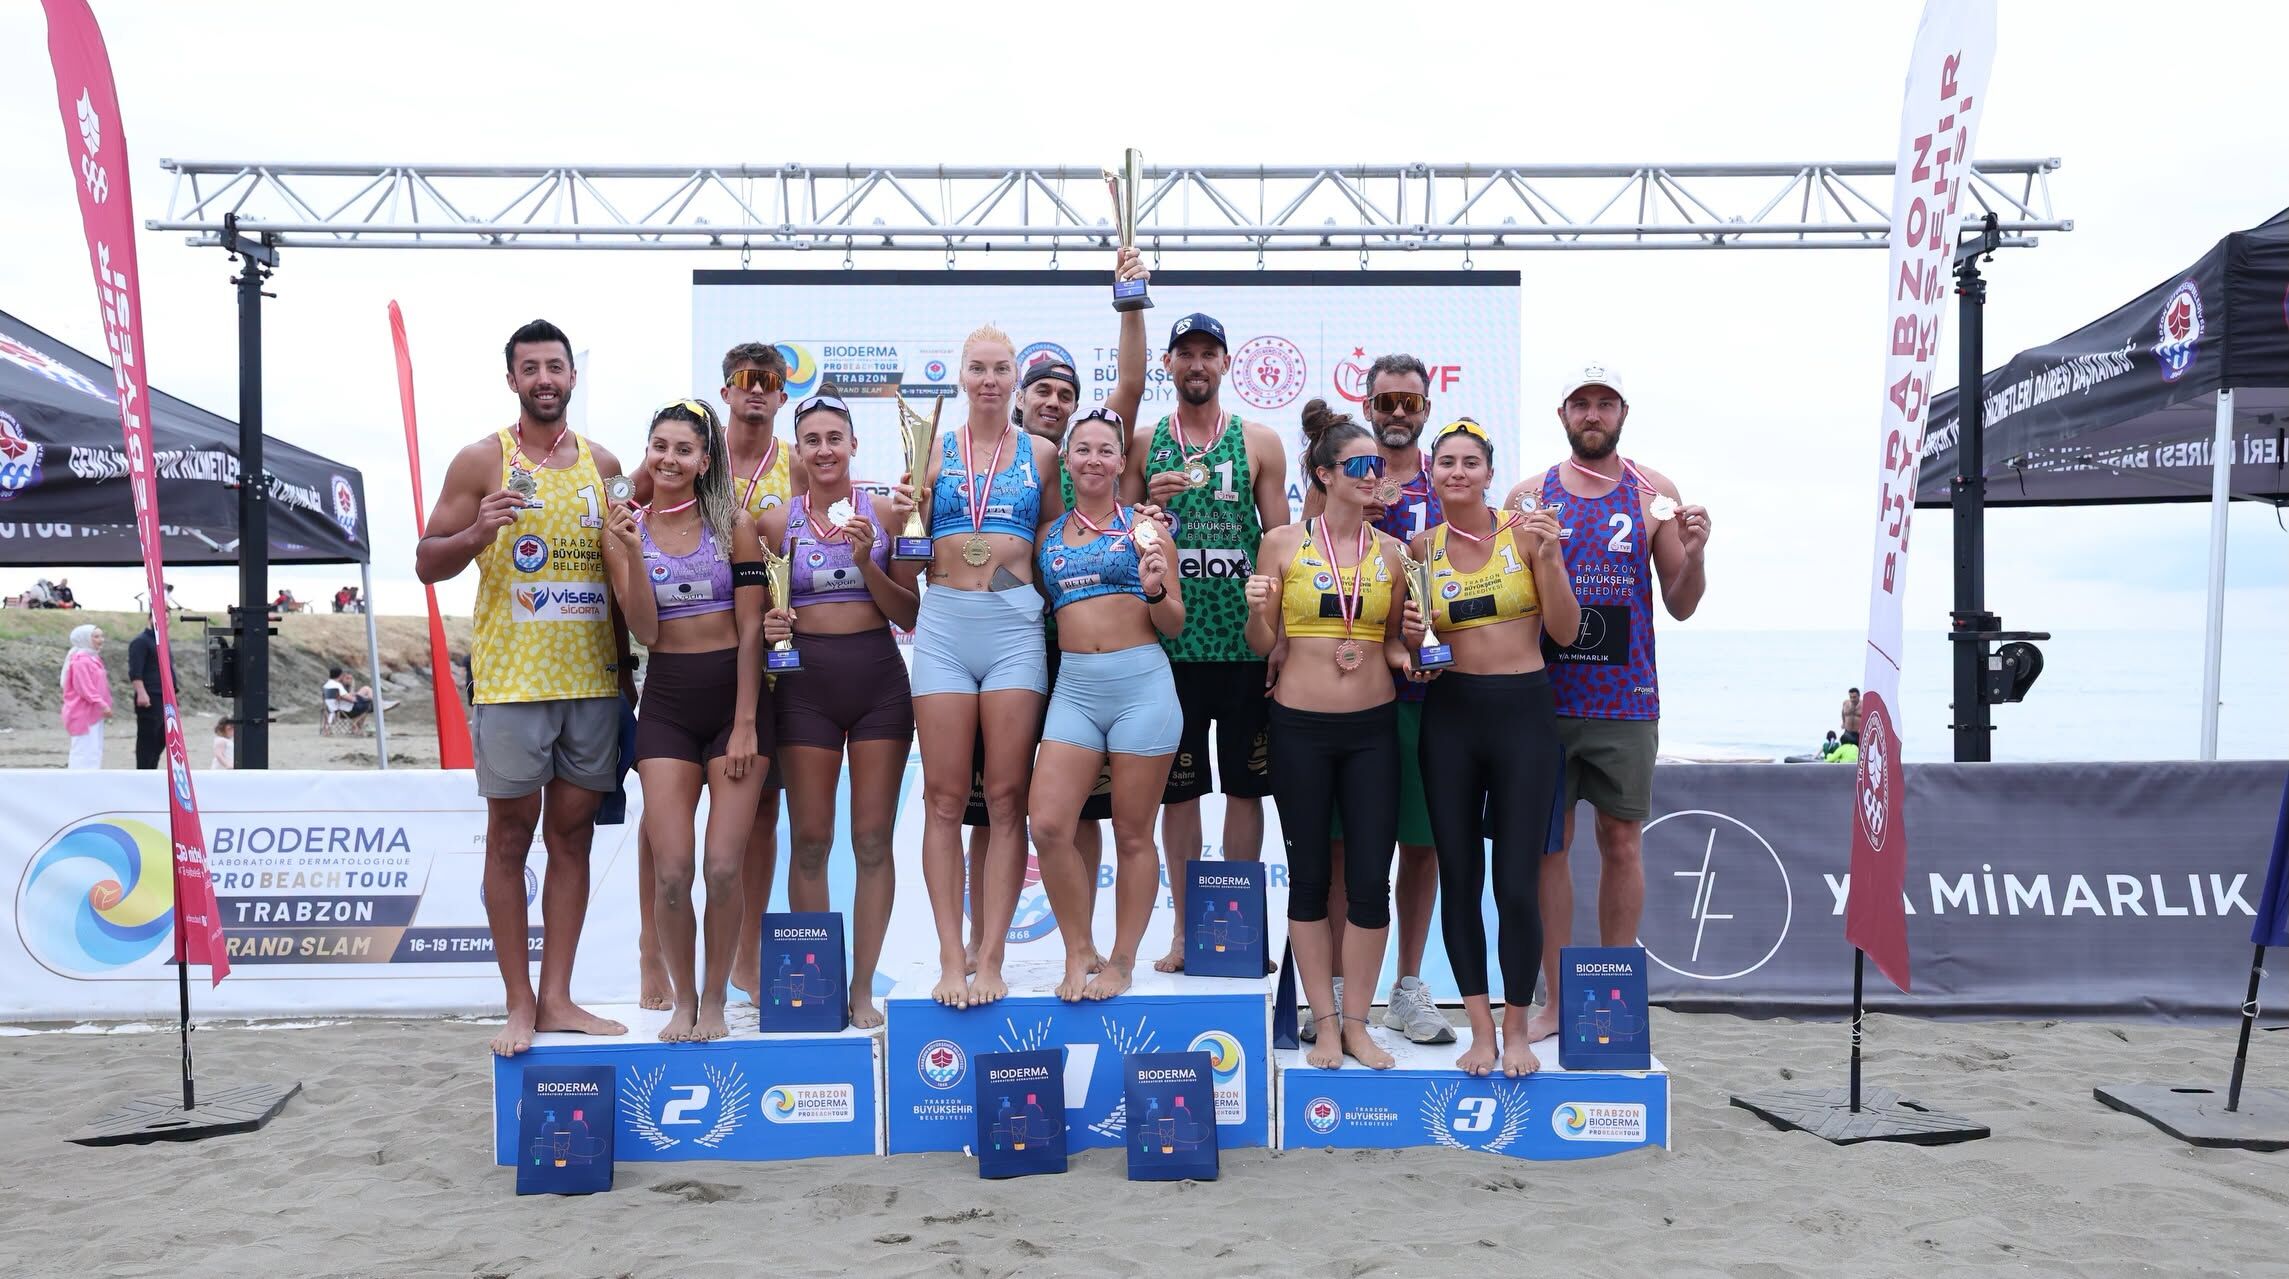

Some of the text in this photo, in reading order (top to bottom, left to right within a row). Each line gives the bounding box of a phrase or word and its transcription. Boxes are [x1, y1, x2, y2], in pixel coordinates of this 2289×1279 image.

[824, 346, 897, 357] BIODERMA
[1094, 348, 1165, 361] TRBZ
[836, 374, 887, 383] TRABZON
[1094, 365, 1173, 385] BÜKŞE
[1428, 366, 1461, 392] VF
[1094, 387, 1172, 402] BEDİY
[1020, 462, 1037, 488] 1
[1214, 460, 1239, 501] 1
[577, 485, 604, 529] 1
[1187, 511, 1244, 522] TRABZON
[1405, 502, 1426, 541] 1
[1187, 533, 1241, 542] BELEDİYES
[1608, 513, 1633, 553] 2
[552, 538, 602, 548] TRABZO
[553, 549, 602, 561] BÜYÜKŞEH
[1500, 544, 1522, 575] 1
[553, 561, 603, 571] BELEDİYE
[1374, 556, 1388, 582] 2
[1577, 564, 1636, 574] TRABZON
[552, 589, 605, 605] VİSERA
[560, 604, 600, 615] SİGORTA
[213, 827, 411, 854] BIODERMA
[211, 857, 410, 866] LABORATOIRE DERMATOLOGIQUE
[1199, 876, 1251, 886] BIODERMA
[1929, 863, 2257, 916] MİMARLIK
[235, 901, 373, 923] TRABZON
[774, 928, 827, 938] BIODERMA
[225, 936, 373, 956] RAND SLAM
[409, 938, 447, 952] 16-19
[451, 938, 493, 952] TEMM
[1576, 963, 1633, 973] BIODERMA
[990, 1066, 1048, 1080] BIODERMA
[1138, 1069, 1197, 1080] BIODERMA
[537, 1082, 599, 1093] BIODERMA
[798, 1090, 847, 1099] TRABZON
[1214, 1091, 1239, 1099] BZON
[661, 1085, 711, 1125] 2
[798, 1099, 848, 1108] BIODERMA
[1215, 1099, 1239, 1107] ERMA
[1453, 1097, 1497, 1132] 3
[1589, 1108, 1640, 1118] TRABZON
[1589, 1118, 1640, 1127] BIODERMA
